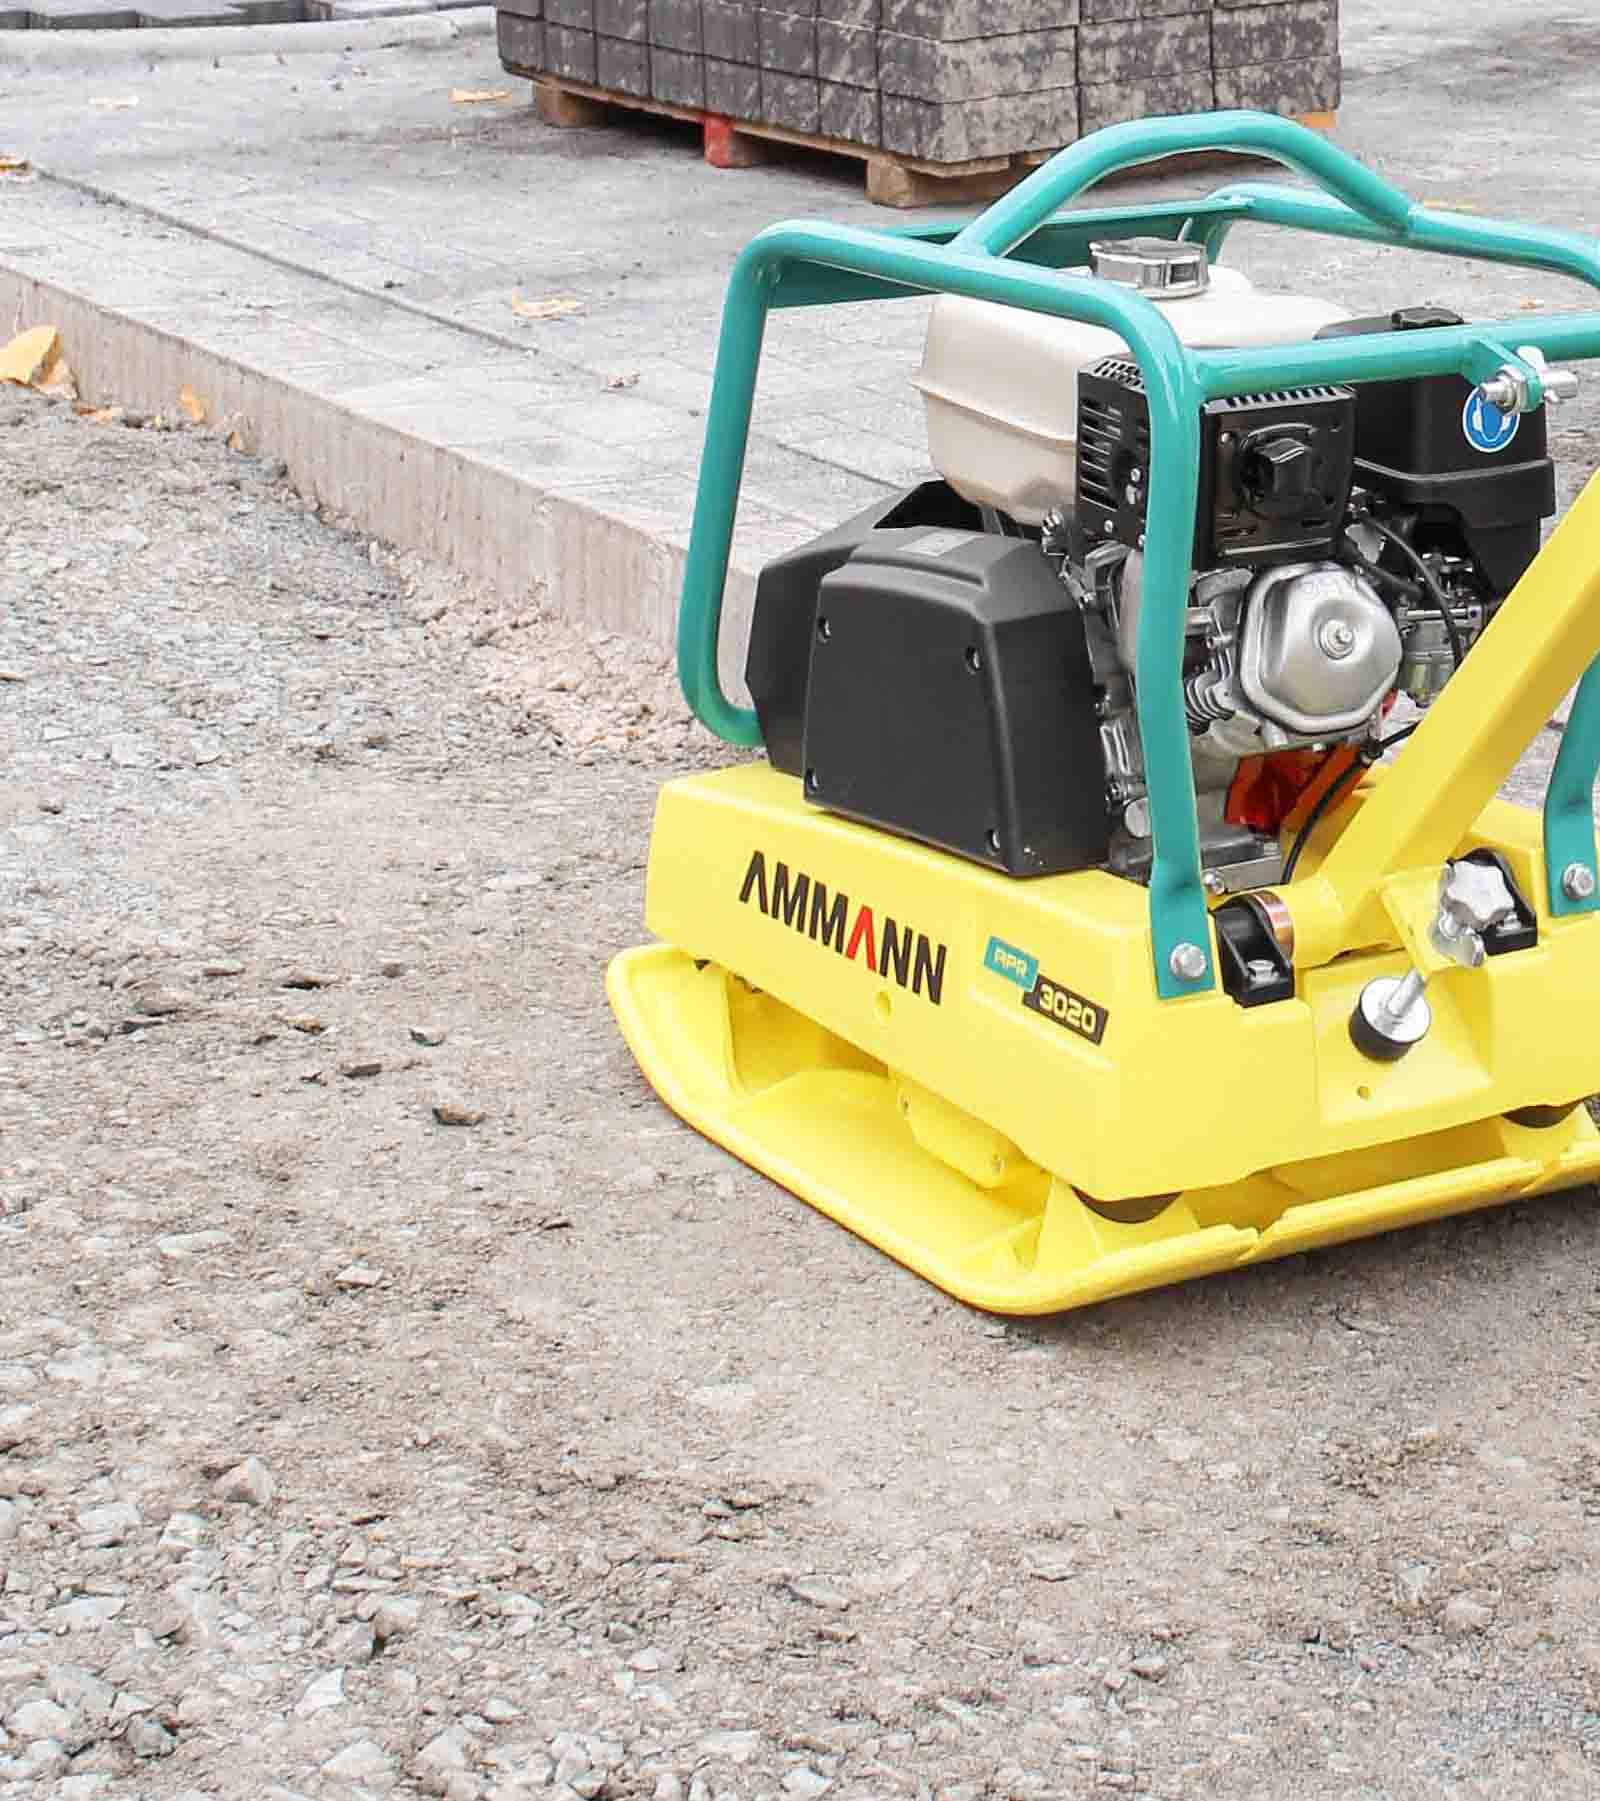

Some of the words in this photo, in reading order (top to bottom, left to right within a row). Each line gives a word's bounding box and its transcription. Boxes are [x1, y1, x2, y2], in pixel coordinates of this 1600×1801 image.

[739, 850, 947, 1005] AMMANN
[993, 946, 1028, 978] APR
[1039, 983, 1096, 1034] 3020
